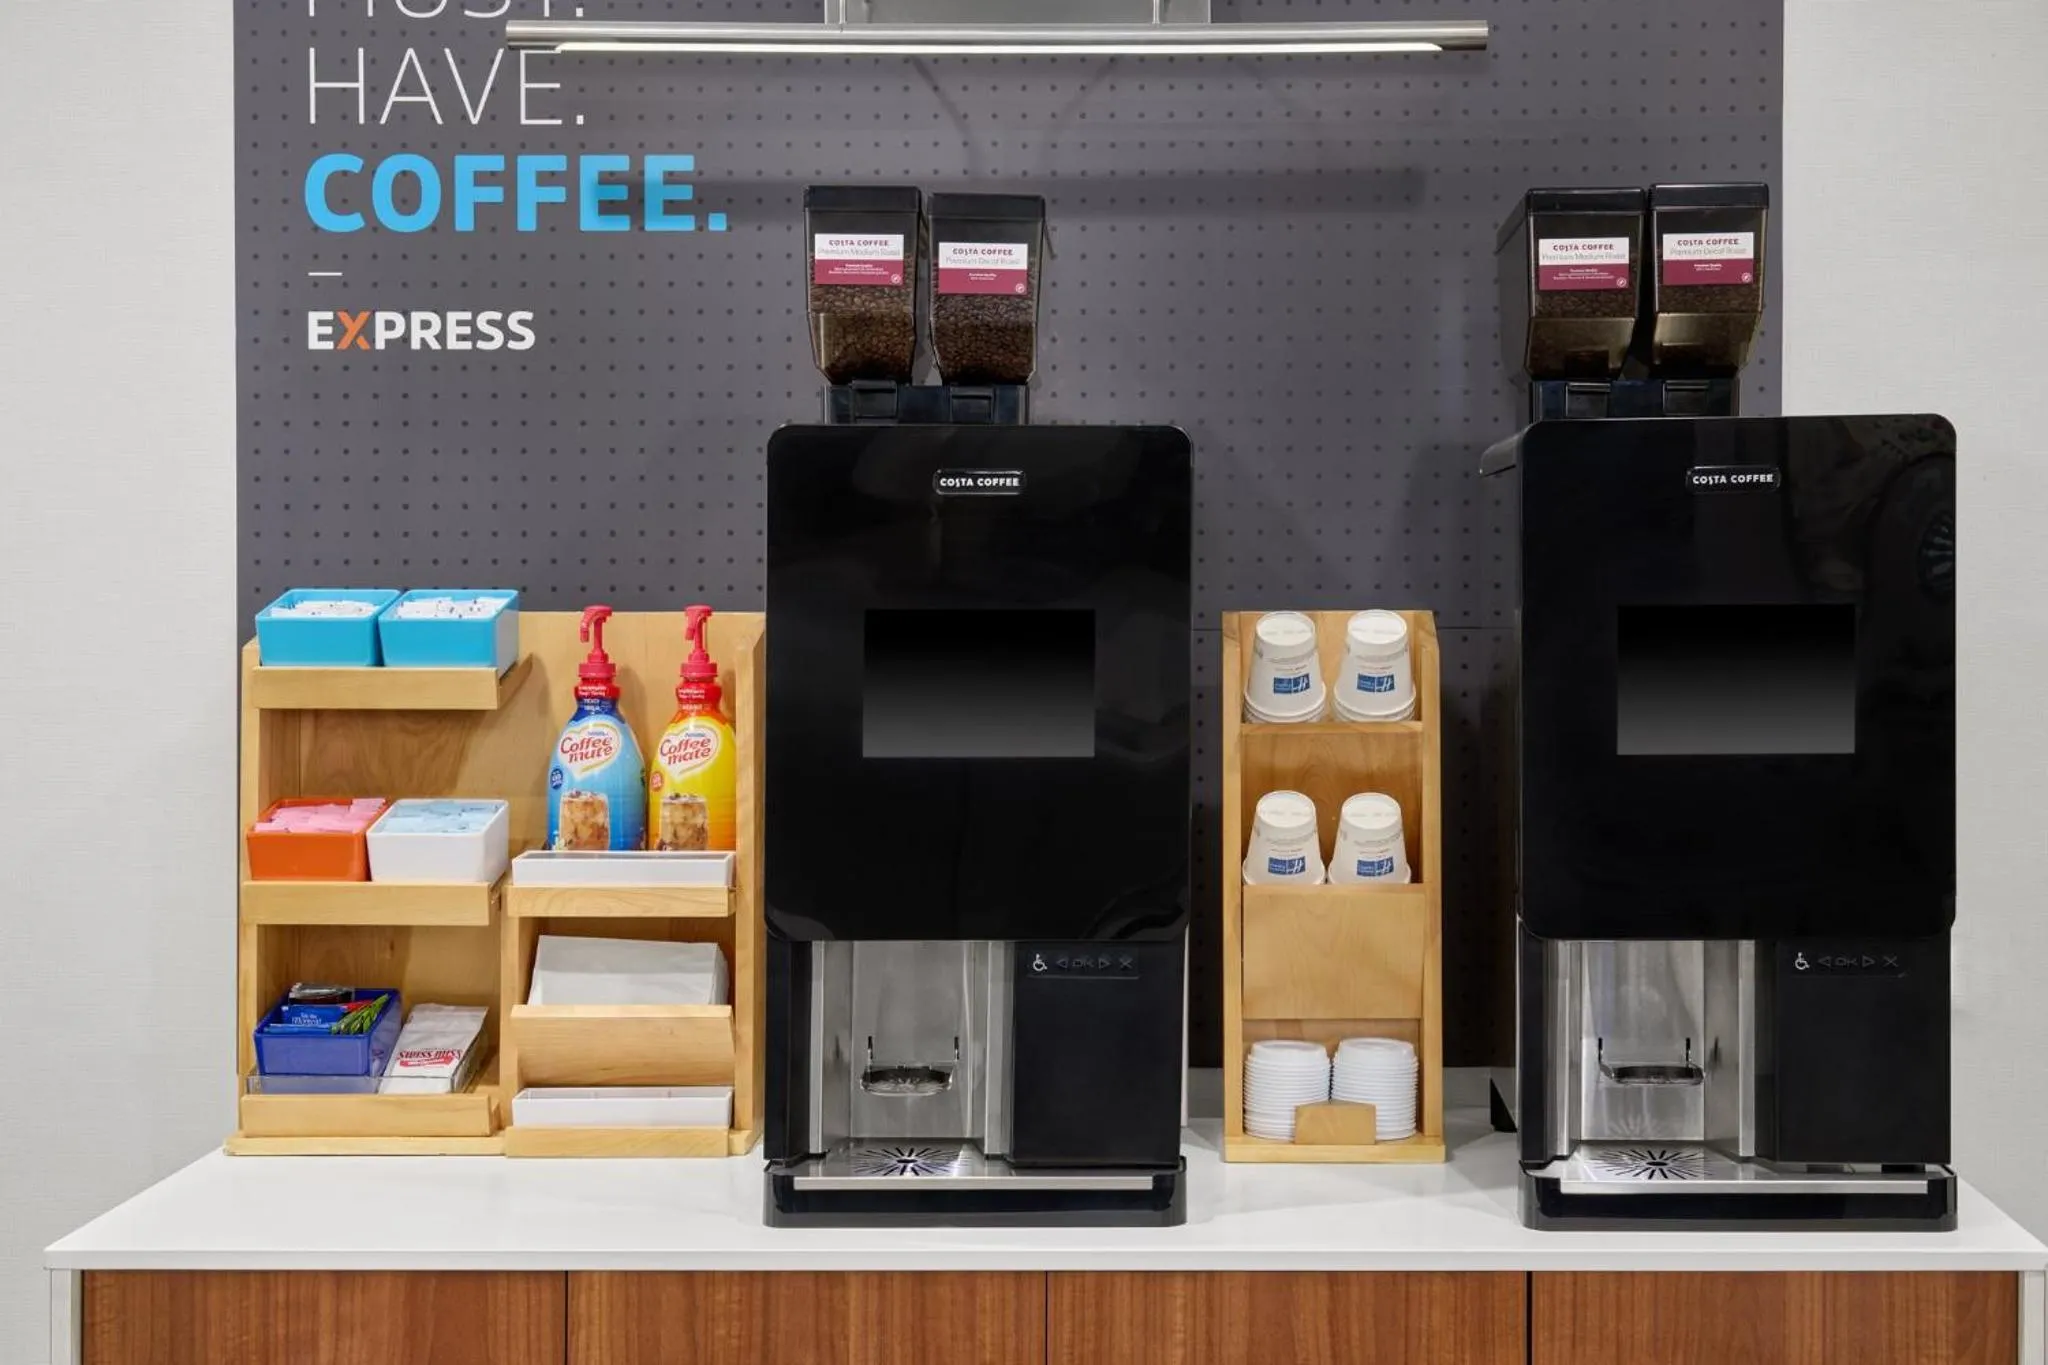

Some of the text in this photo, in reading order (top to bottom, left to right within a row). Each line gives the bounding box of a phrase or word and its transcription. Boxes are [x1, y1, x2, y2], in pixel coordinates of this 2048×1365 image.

[308, 47, 585, 125] HAVE.
[304, 152, 727, 233] COFFEE.
[828, 239, 889, 247] COSTA COFFEE
[1553, 243, 1614, 252] COSTA COFFEE
[1677, 238, 1739, 247] COSTA COFFEE
[952, 247, 1014, 256] COSTA COFFEE
[307, 310, 536, 351] EXPRESS
[940, 477, 1020, 488] COSTA COFFEE
[1692, 473, 1774, 485] COSTA COFFEE
[560, 736, 613, 755] Coffee
[660, 738, 711, 757] Coffee
[667, 747, 711, 766] mate
